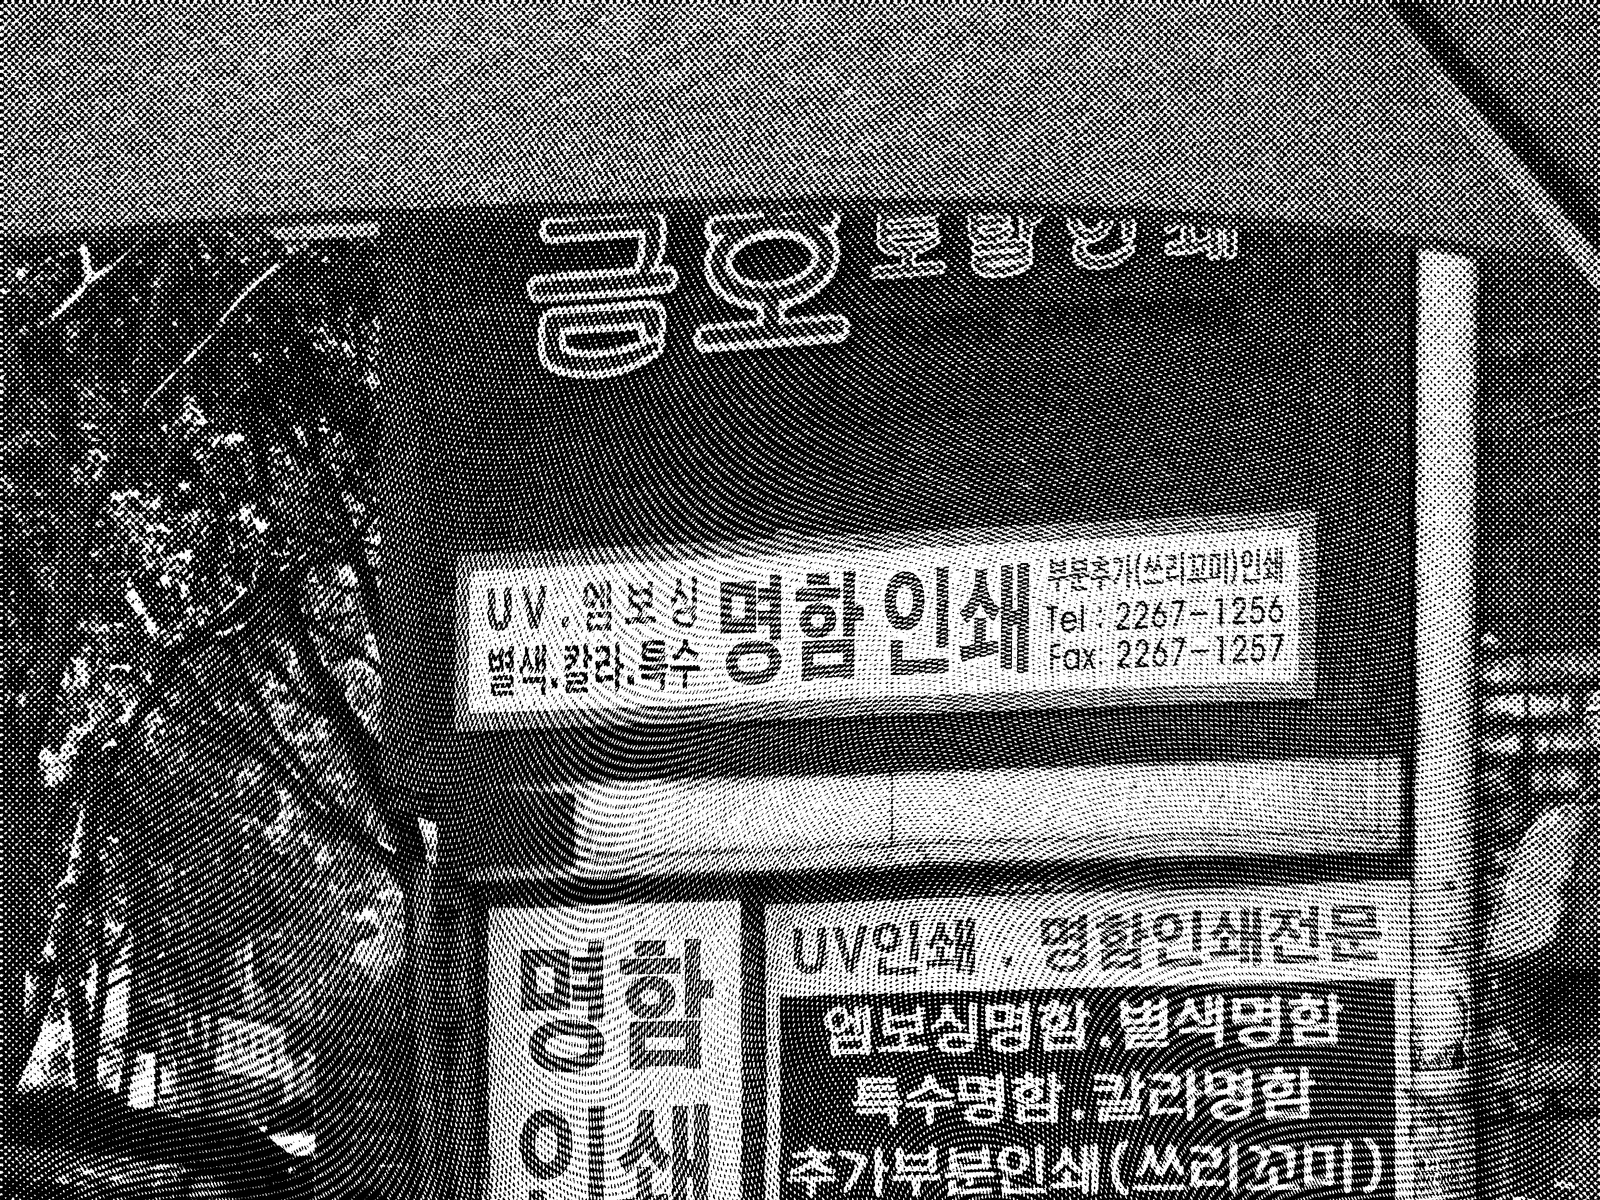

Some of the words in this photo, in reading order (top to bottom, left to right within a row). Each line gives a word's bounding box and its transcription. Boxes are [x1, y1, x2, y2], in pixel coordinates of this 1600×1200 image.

[720, 570, 865, 686] 명함
[883, 561, 1030, 677] 인쇄
[1046, 603, 1085, 634] Tel
[1115, 596, 1285, 631] 2267-1256
[1116, 633, 1285, 669] 2267-1257
[792, 916, 977, 976] UV인쇄
[520, 938, 714, 1072] 명함
